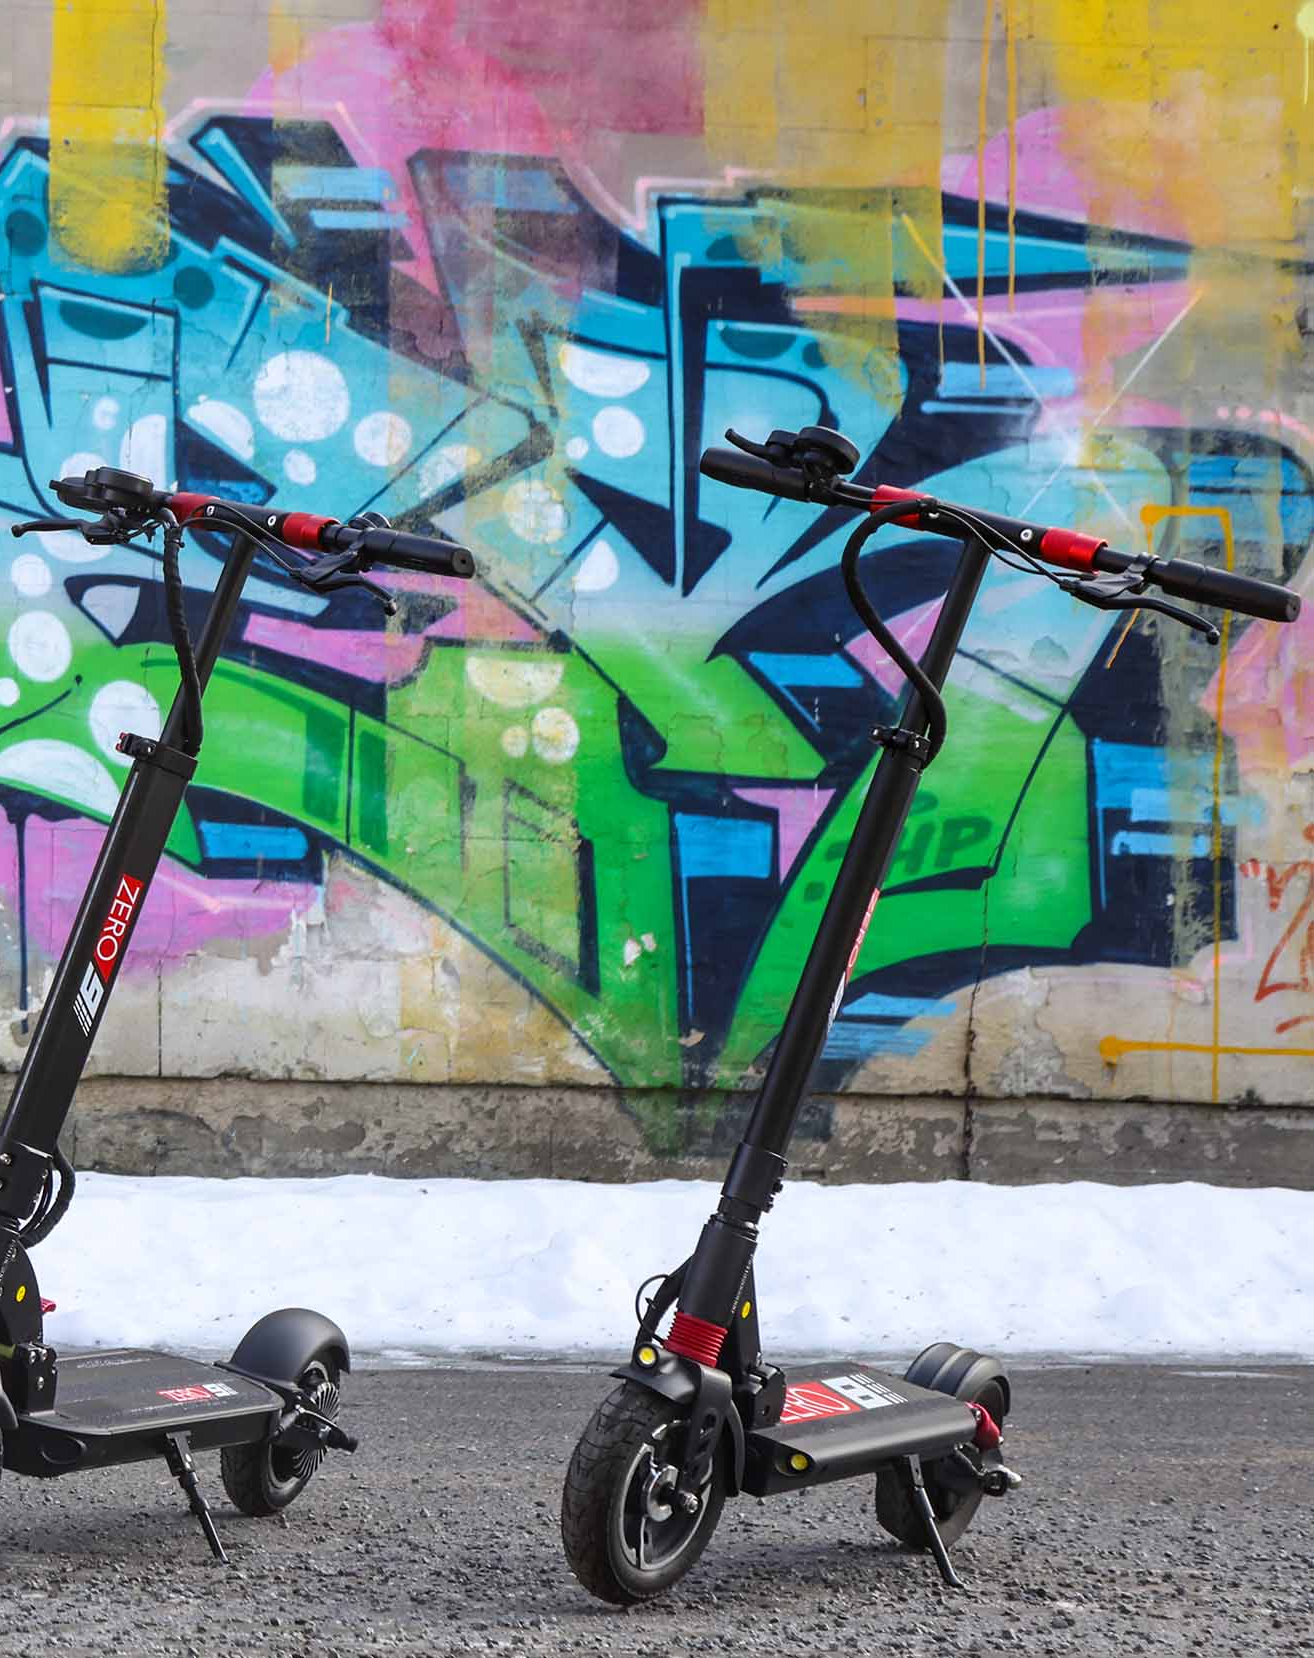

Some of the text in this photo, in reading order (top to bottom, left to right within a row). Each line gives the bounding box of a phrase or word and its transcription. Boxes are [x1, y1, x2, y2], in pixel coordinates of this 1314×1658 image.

[79, 878, 140, 1019] ZERO 9
[158, 1387, 212, 1401] ZERO
[820, 1376, 894, 1409] 8
